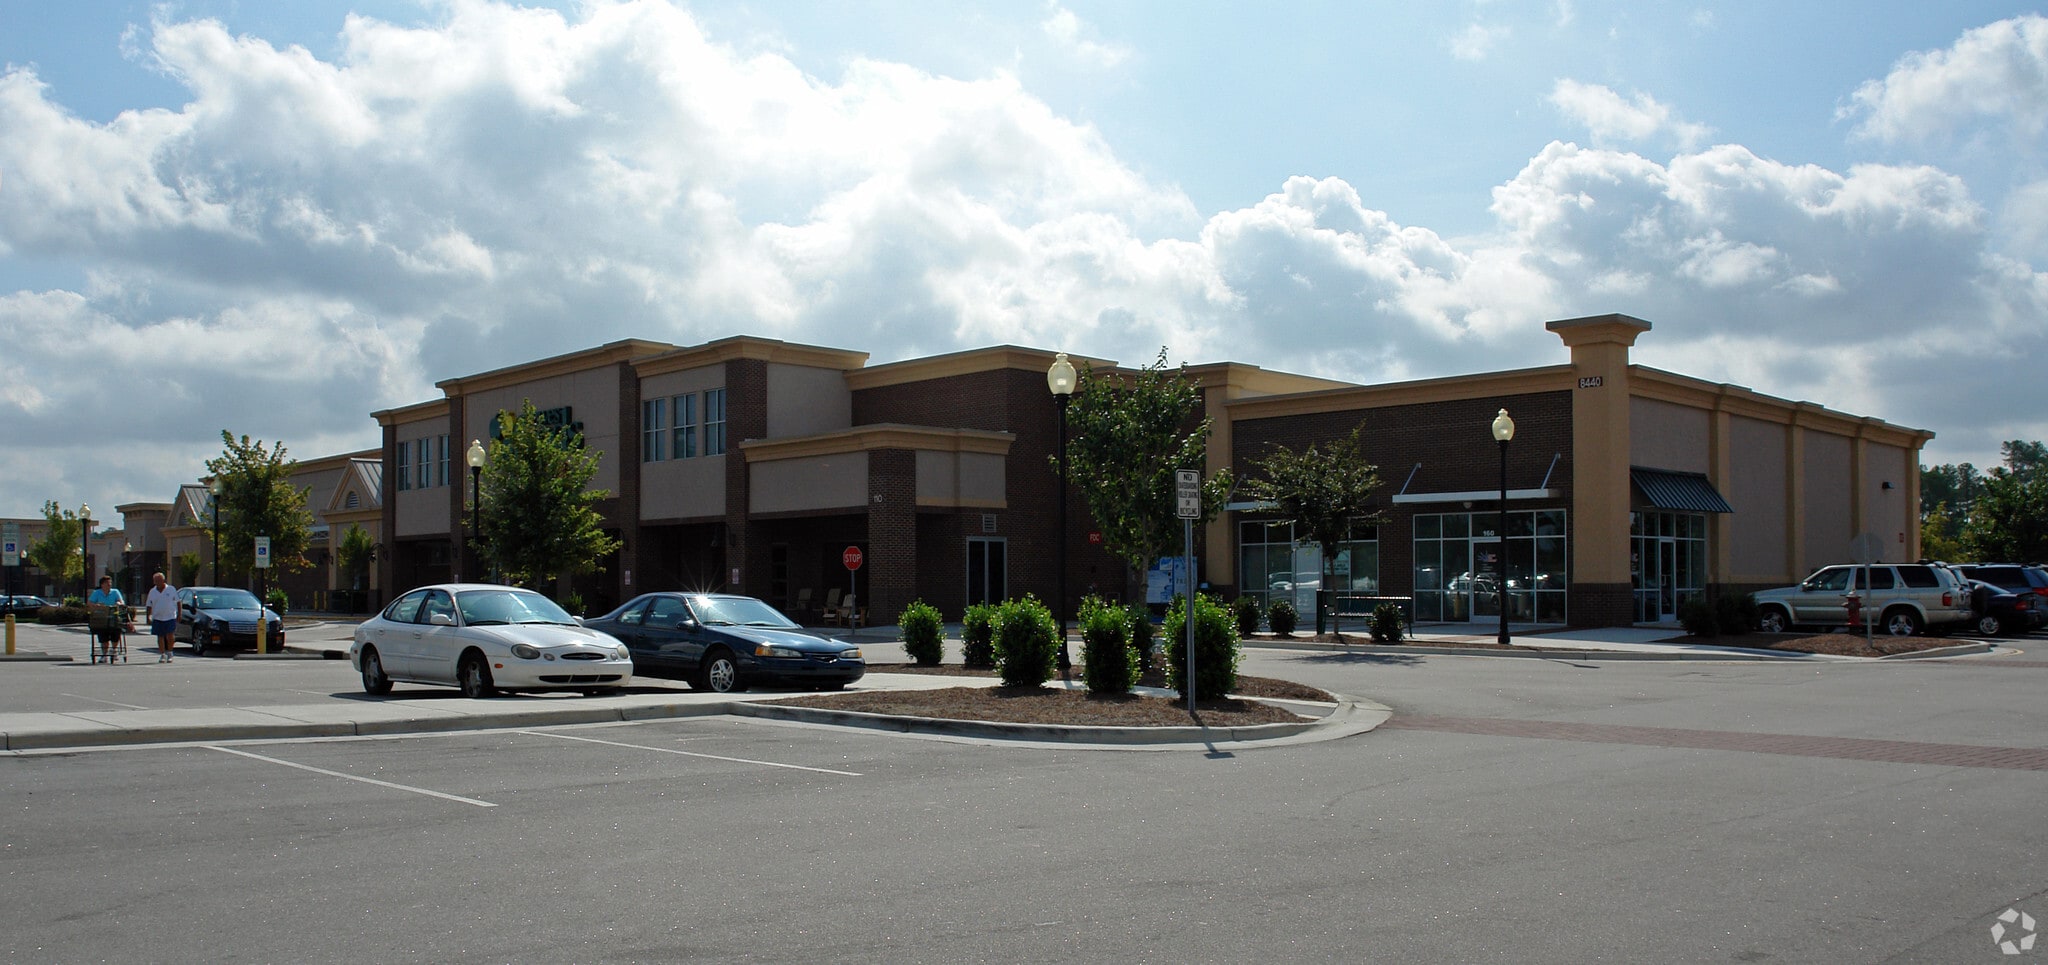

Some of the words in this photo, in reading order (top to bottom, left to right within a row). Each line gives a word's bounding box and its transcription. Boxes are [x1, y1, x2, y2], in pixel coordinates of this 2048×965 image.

[1580, 377, 1601, 388] 8440
[1183, 473, 1193, 481] NO
[873, 494, 883, 503] 110
[844, 553, 861, 563] STOP
